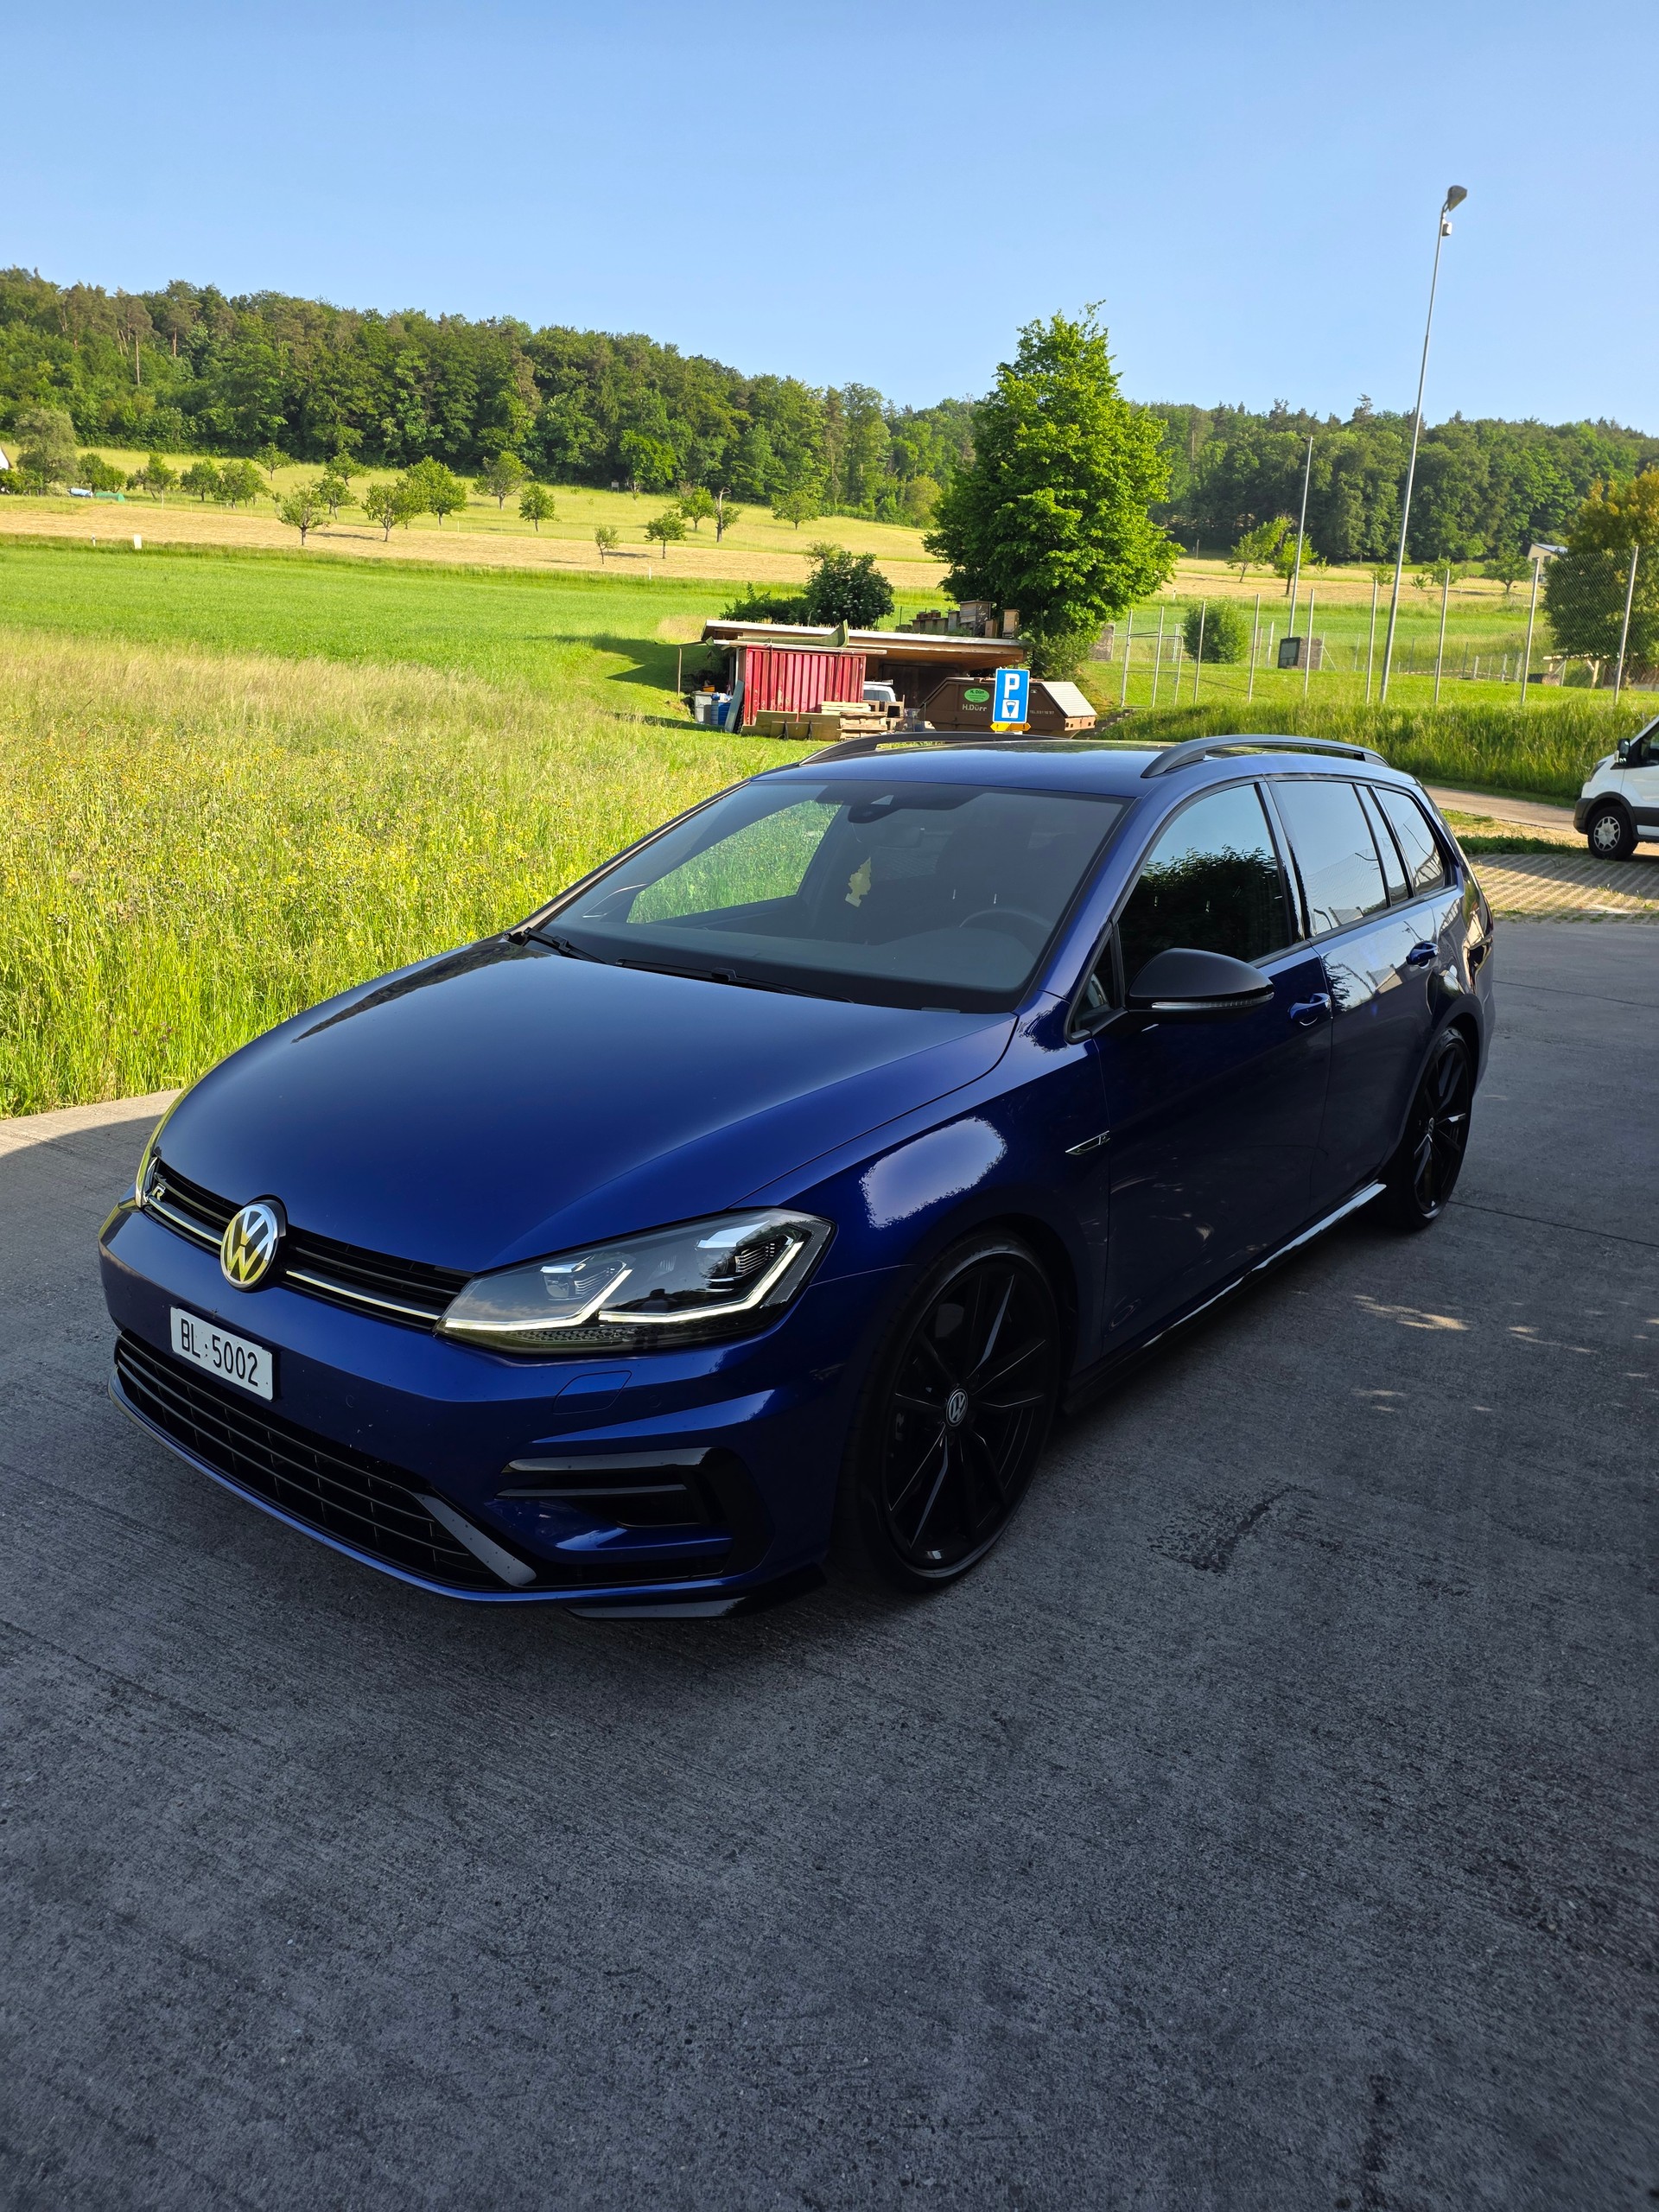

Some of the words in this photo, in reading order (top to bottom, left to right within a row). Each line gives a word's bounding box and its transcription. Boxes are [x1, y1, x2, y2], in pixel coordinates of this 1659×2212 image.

[1004, 673, 1020, 699] P
[181, 1318, 201, 1359] BL
[212, 1333, 258, 1388] 5002
